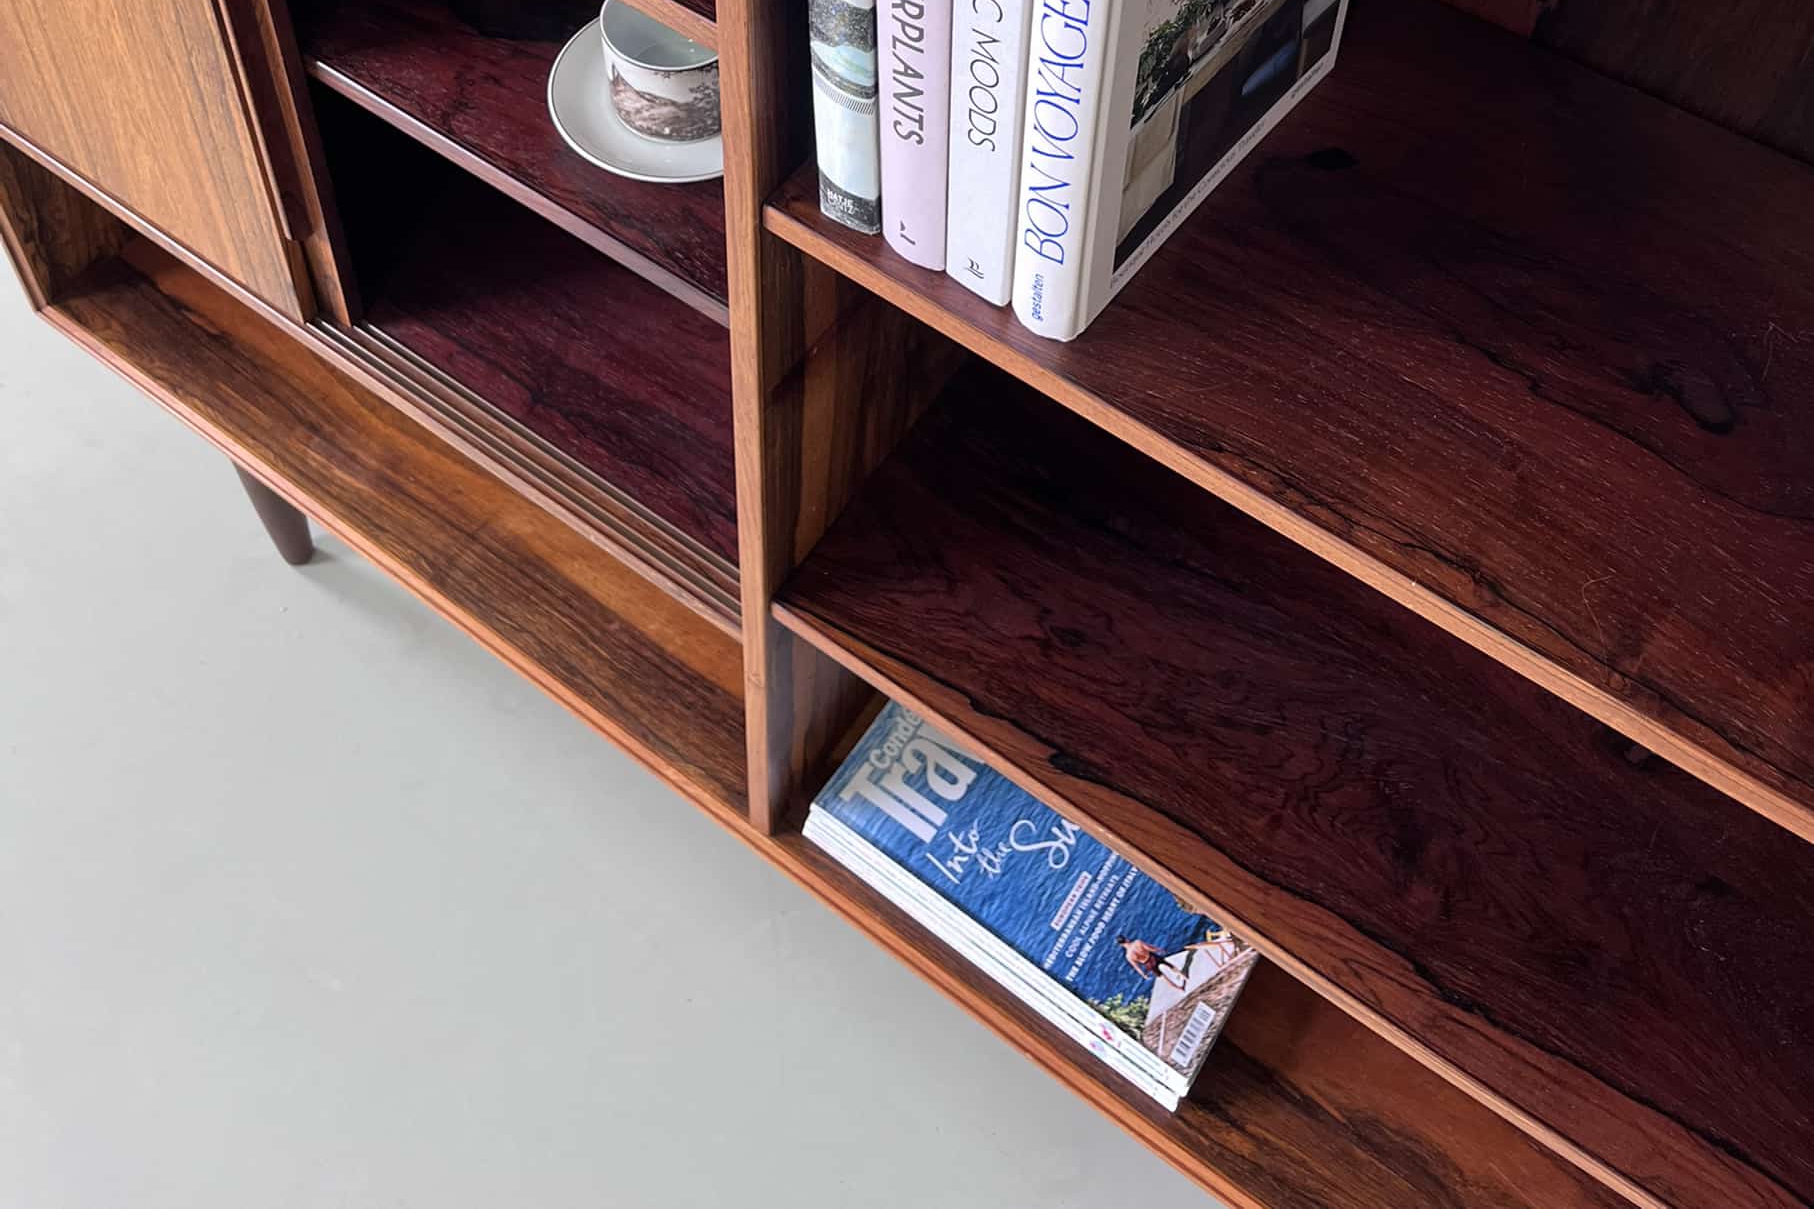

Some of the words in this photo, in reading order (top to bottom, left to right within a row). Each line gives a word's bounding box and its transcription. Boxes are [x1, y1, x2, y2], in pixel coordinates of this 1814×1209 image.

[967, 27, 1002, 152] MOODS
[1024, 161, 1071, 265] BON
[1031, 273, 1045, 322] gestalten
[926, 818, 980, 885] Into
[976, 841, 1012, 879] the
[1065, 936, 1083, 959] COOL
